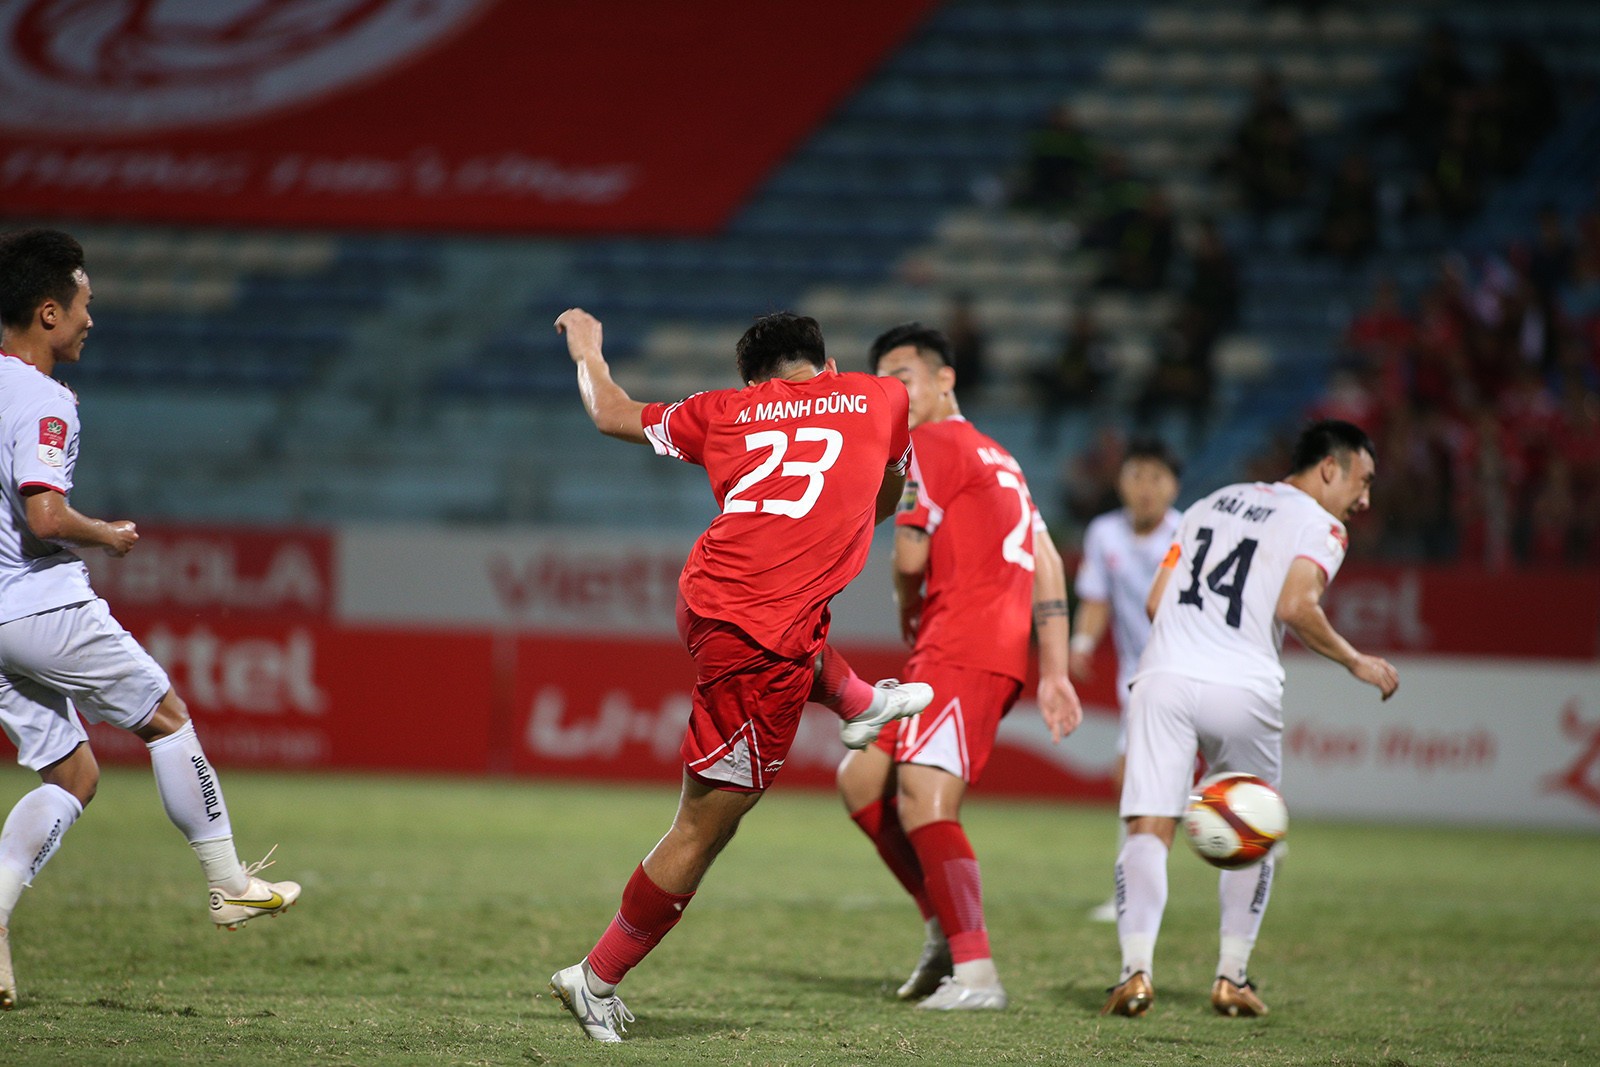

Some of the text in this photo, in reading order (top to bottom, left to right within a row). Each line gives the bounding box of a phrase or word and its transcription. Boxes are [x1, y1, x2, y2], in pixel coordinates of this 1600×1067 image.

[734, 391, 868, 424] N. MẠNH DŨNG
[722, 427, 844, 519] 23
[1178, 527, 1259, 629] 14
[191, 755, 222, 822] JOGARBOLA
